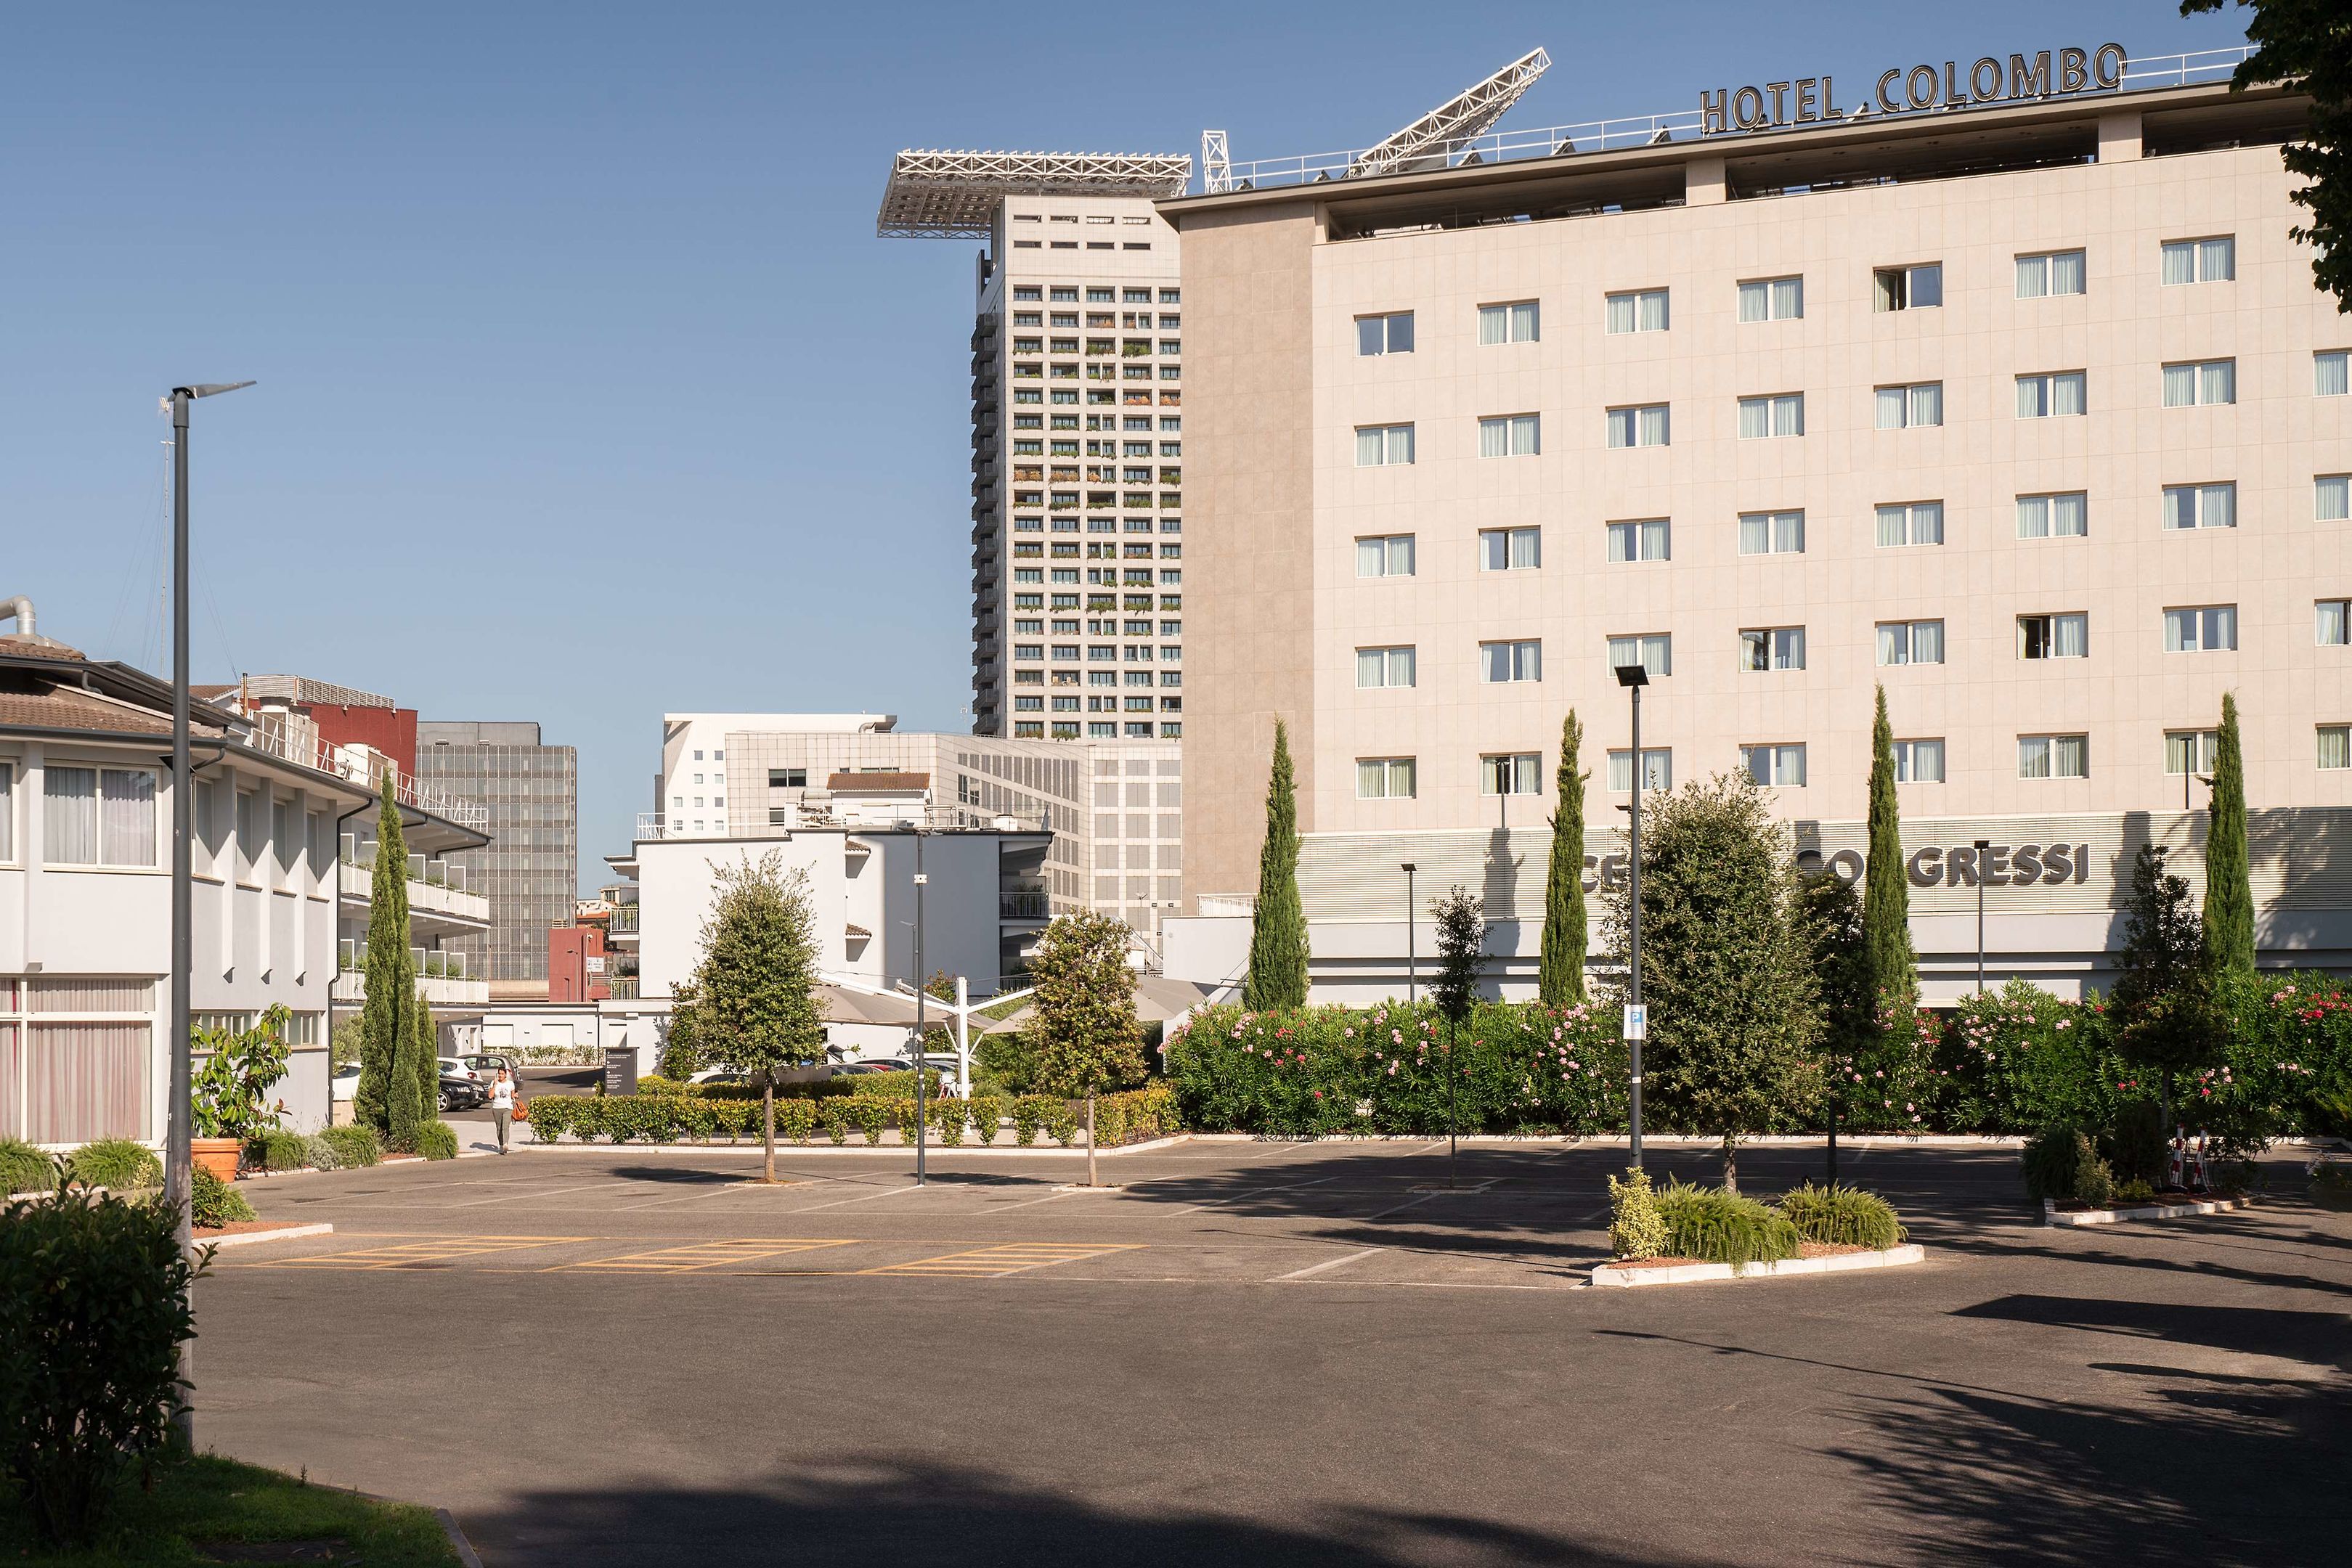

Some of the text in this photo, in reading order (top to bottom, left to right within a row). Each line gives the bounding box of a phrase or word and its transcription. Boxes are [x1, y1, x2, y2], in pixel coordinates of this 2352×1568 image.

[1701, 43, 2127, 134] HOTEL COLOMBO
[1632, 1013, 1639, 1022] P
